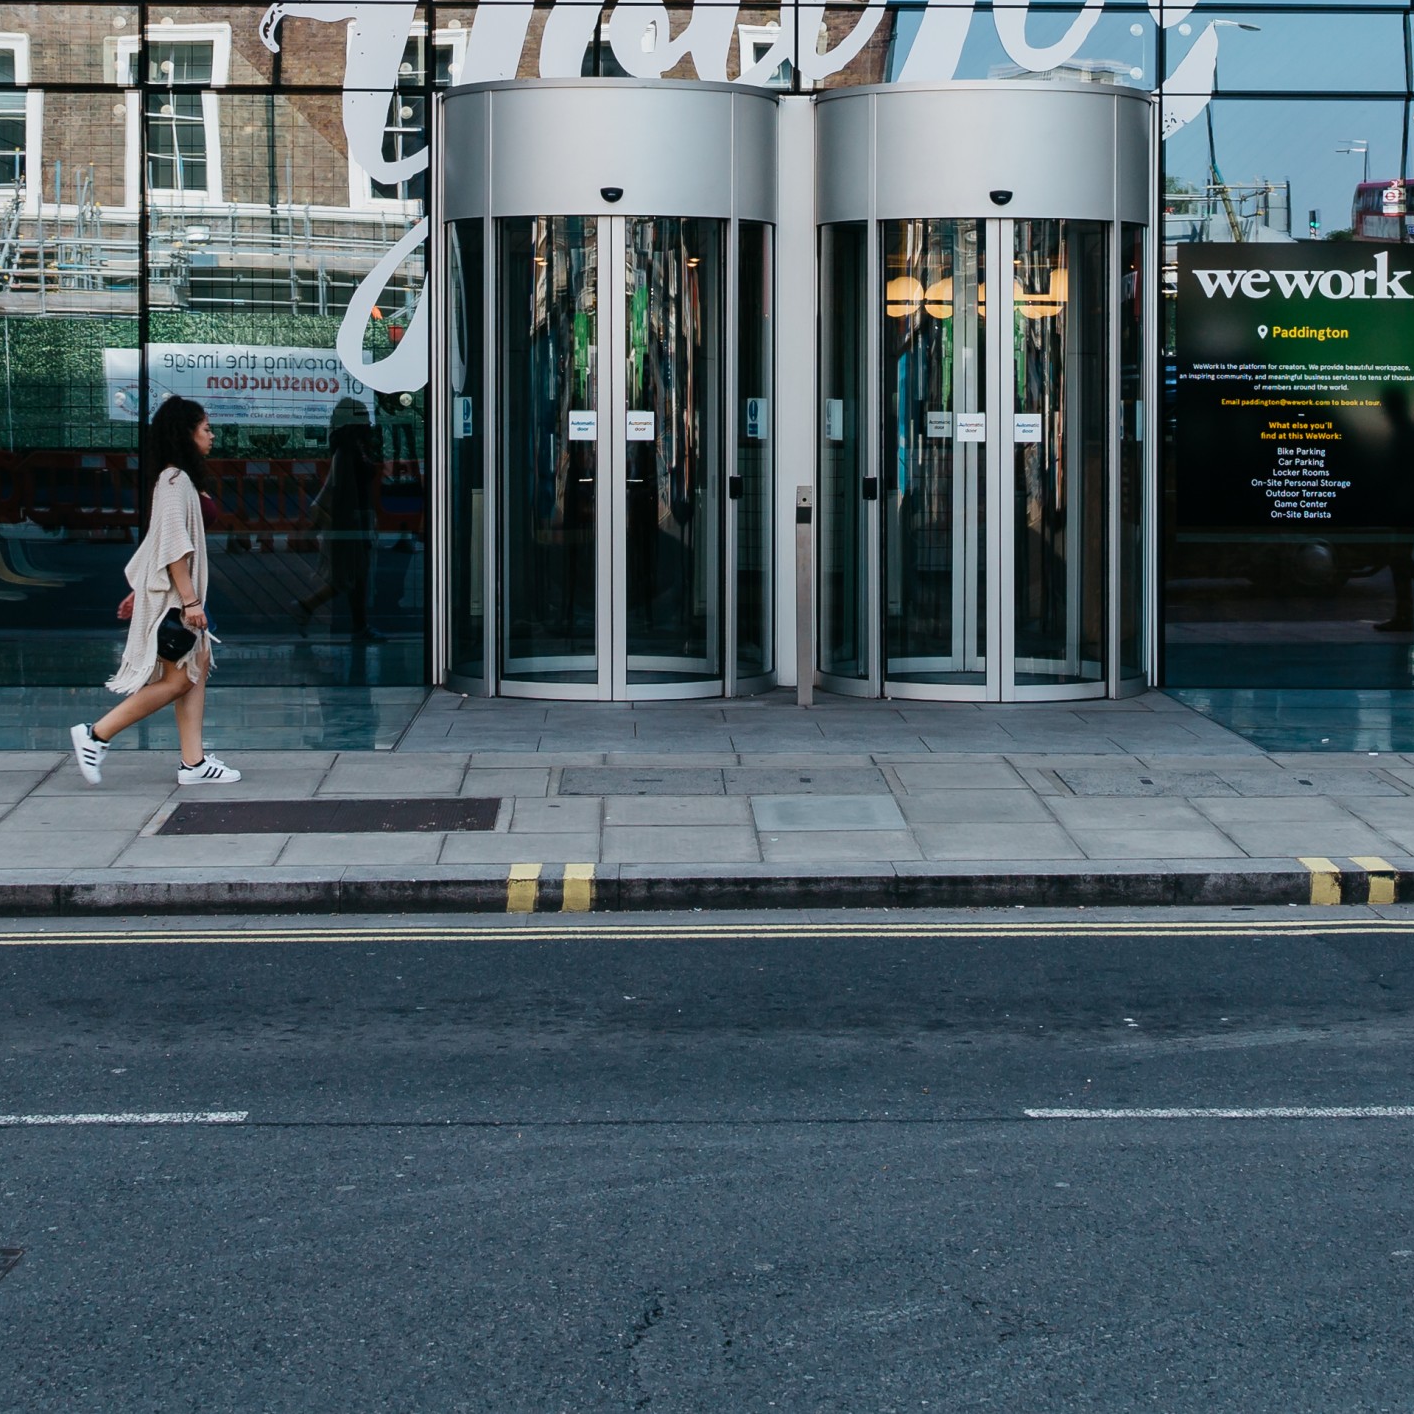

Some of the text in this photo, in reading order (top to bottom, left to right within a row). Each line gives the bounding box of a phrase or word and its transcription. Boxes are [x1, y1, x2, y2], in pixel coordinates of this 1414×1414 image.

[1191, 250, 1414, 300] wework
[1272, 326, 1349, 341] Paddington
[1238, 363, 1267, 372] platform
[1320, 364, 1344, 372] provide
[1188, 373, 1215, 381] inspiring
[1268, 373, 1303, 382] meaningful
[1241, 398, 1331, 407] paddington@wework.com
[1268, 421, 1290, 429] What
[1292, 421, 1309, 429] else
[1305, 432, 1342, 440] WeWork:
[1277, 447, 1326, 457] Bike Parking
[1278, 457, 1325, 467] Car Parking
[1272, 468, 1330, 476] Locker Rooms
[1251, 479, 1351, 489] On-Site Personal Storage
[1265, 489, 1336, 497] Outdoor Terraces
[1274, 500, 1328, 508] Game Center
[1270, 510, 1332, 518] On-Site Barista
